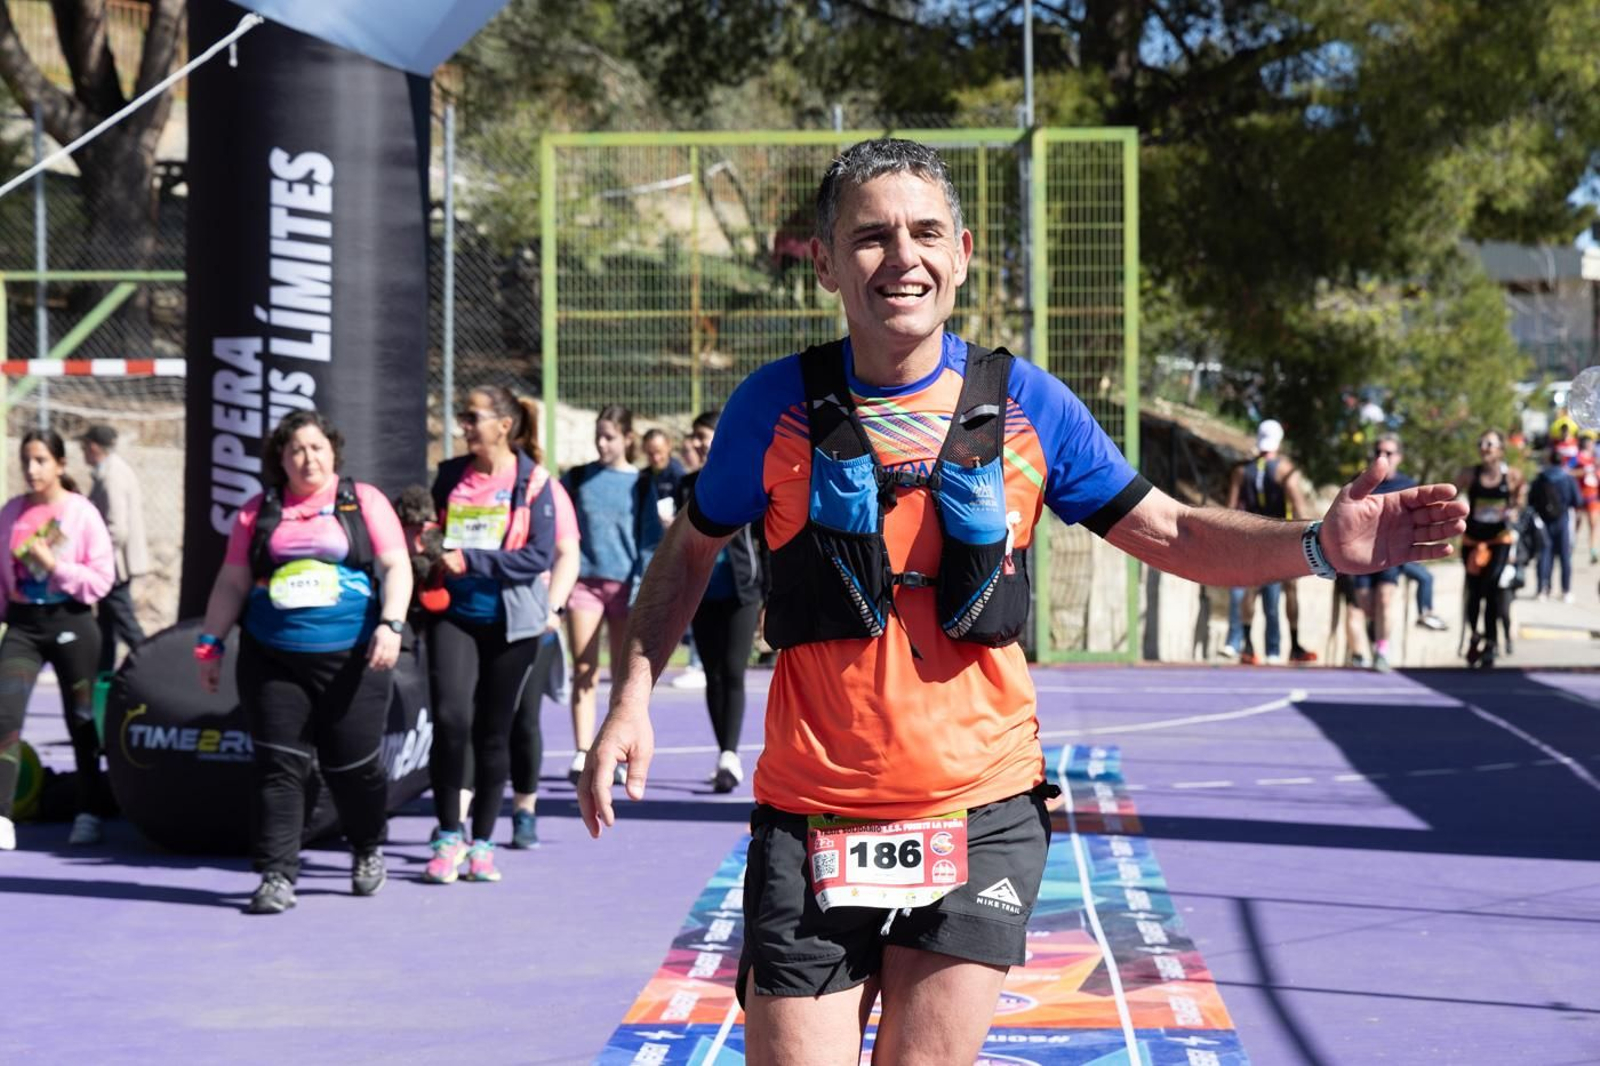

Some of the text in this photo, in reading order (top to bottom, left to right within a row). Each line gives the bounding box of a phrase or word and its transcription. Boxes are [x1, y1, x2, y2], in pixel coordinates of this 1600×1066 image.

[254, 146, 334, 362] LÍMITES
[932, 821, 942, 829] LA
[849, 839, 922, 869] 186
[976, 897, 1020, 915] NIKE TRAIL
